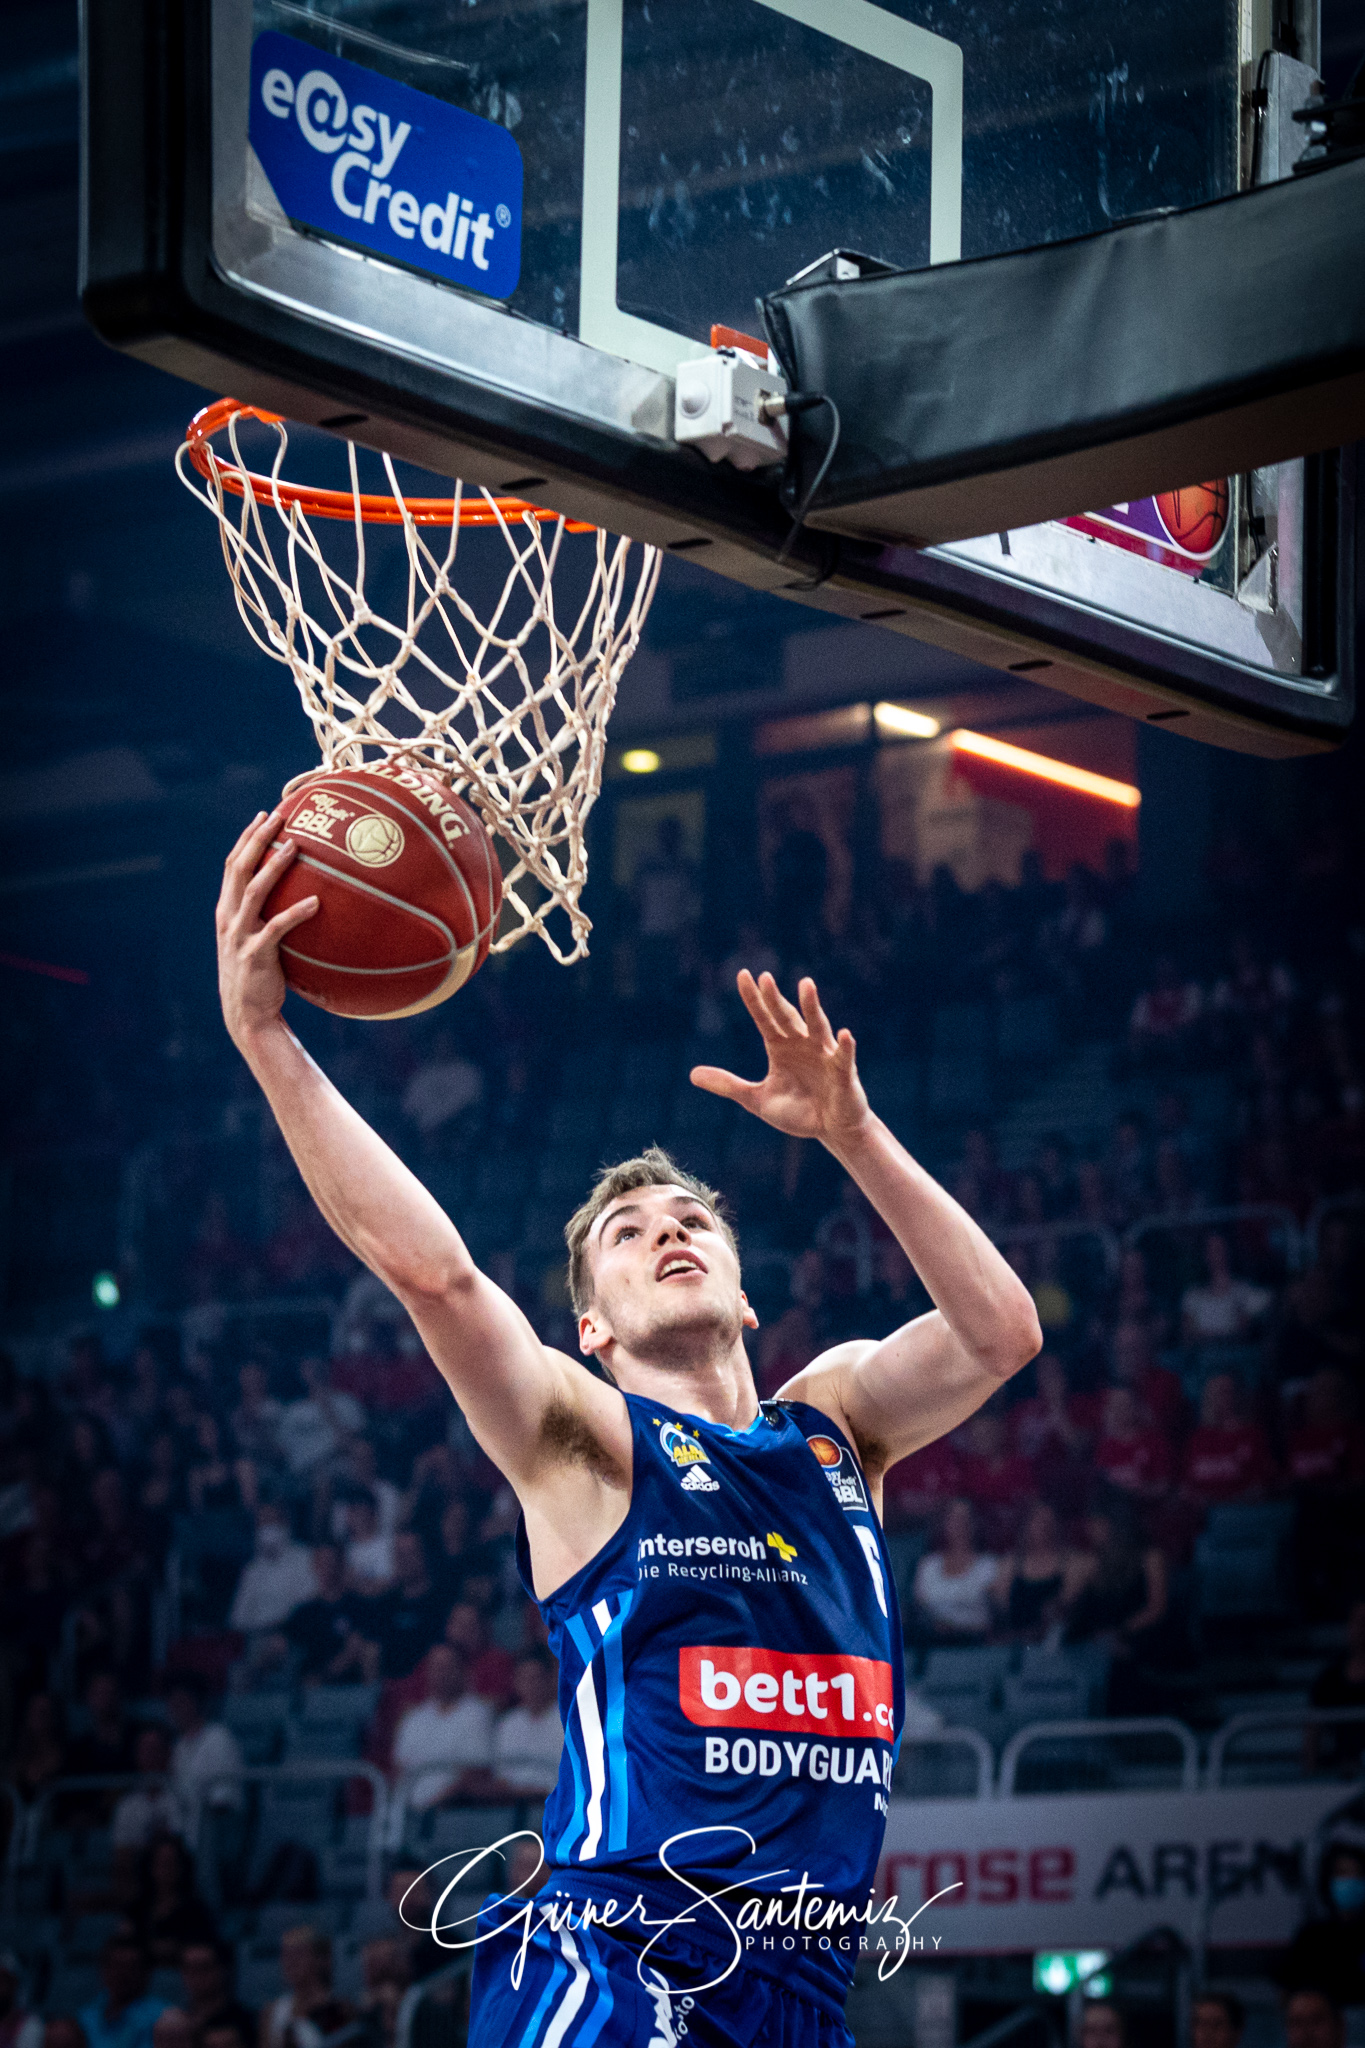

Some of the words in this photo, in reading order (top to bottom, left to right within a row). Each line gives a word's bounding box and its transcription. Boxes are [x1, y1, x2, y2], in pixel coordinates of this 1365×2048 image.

[291, 809, 337, 839] BBL
[883, 1845, 1077, 1908] rose
[1094, 1838, 1308, 1901] AREN
